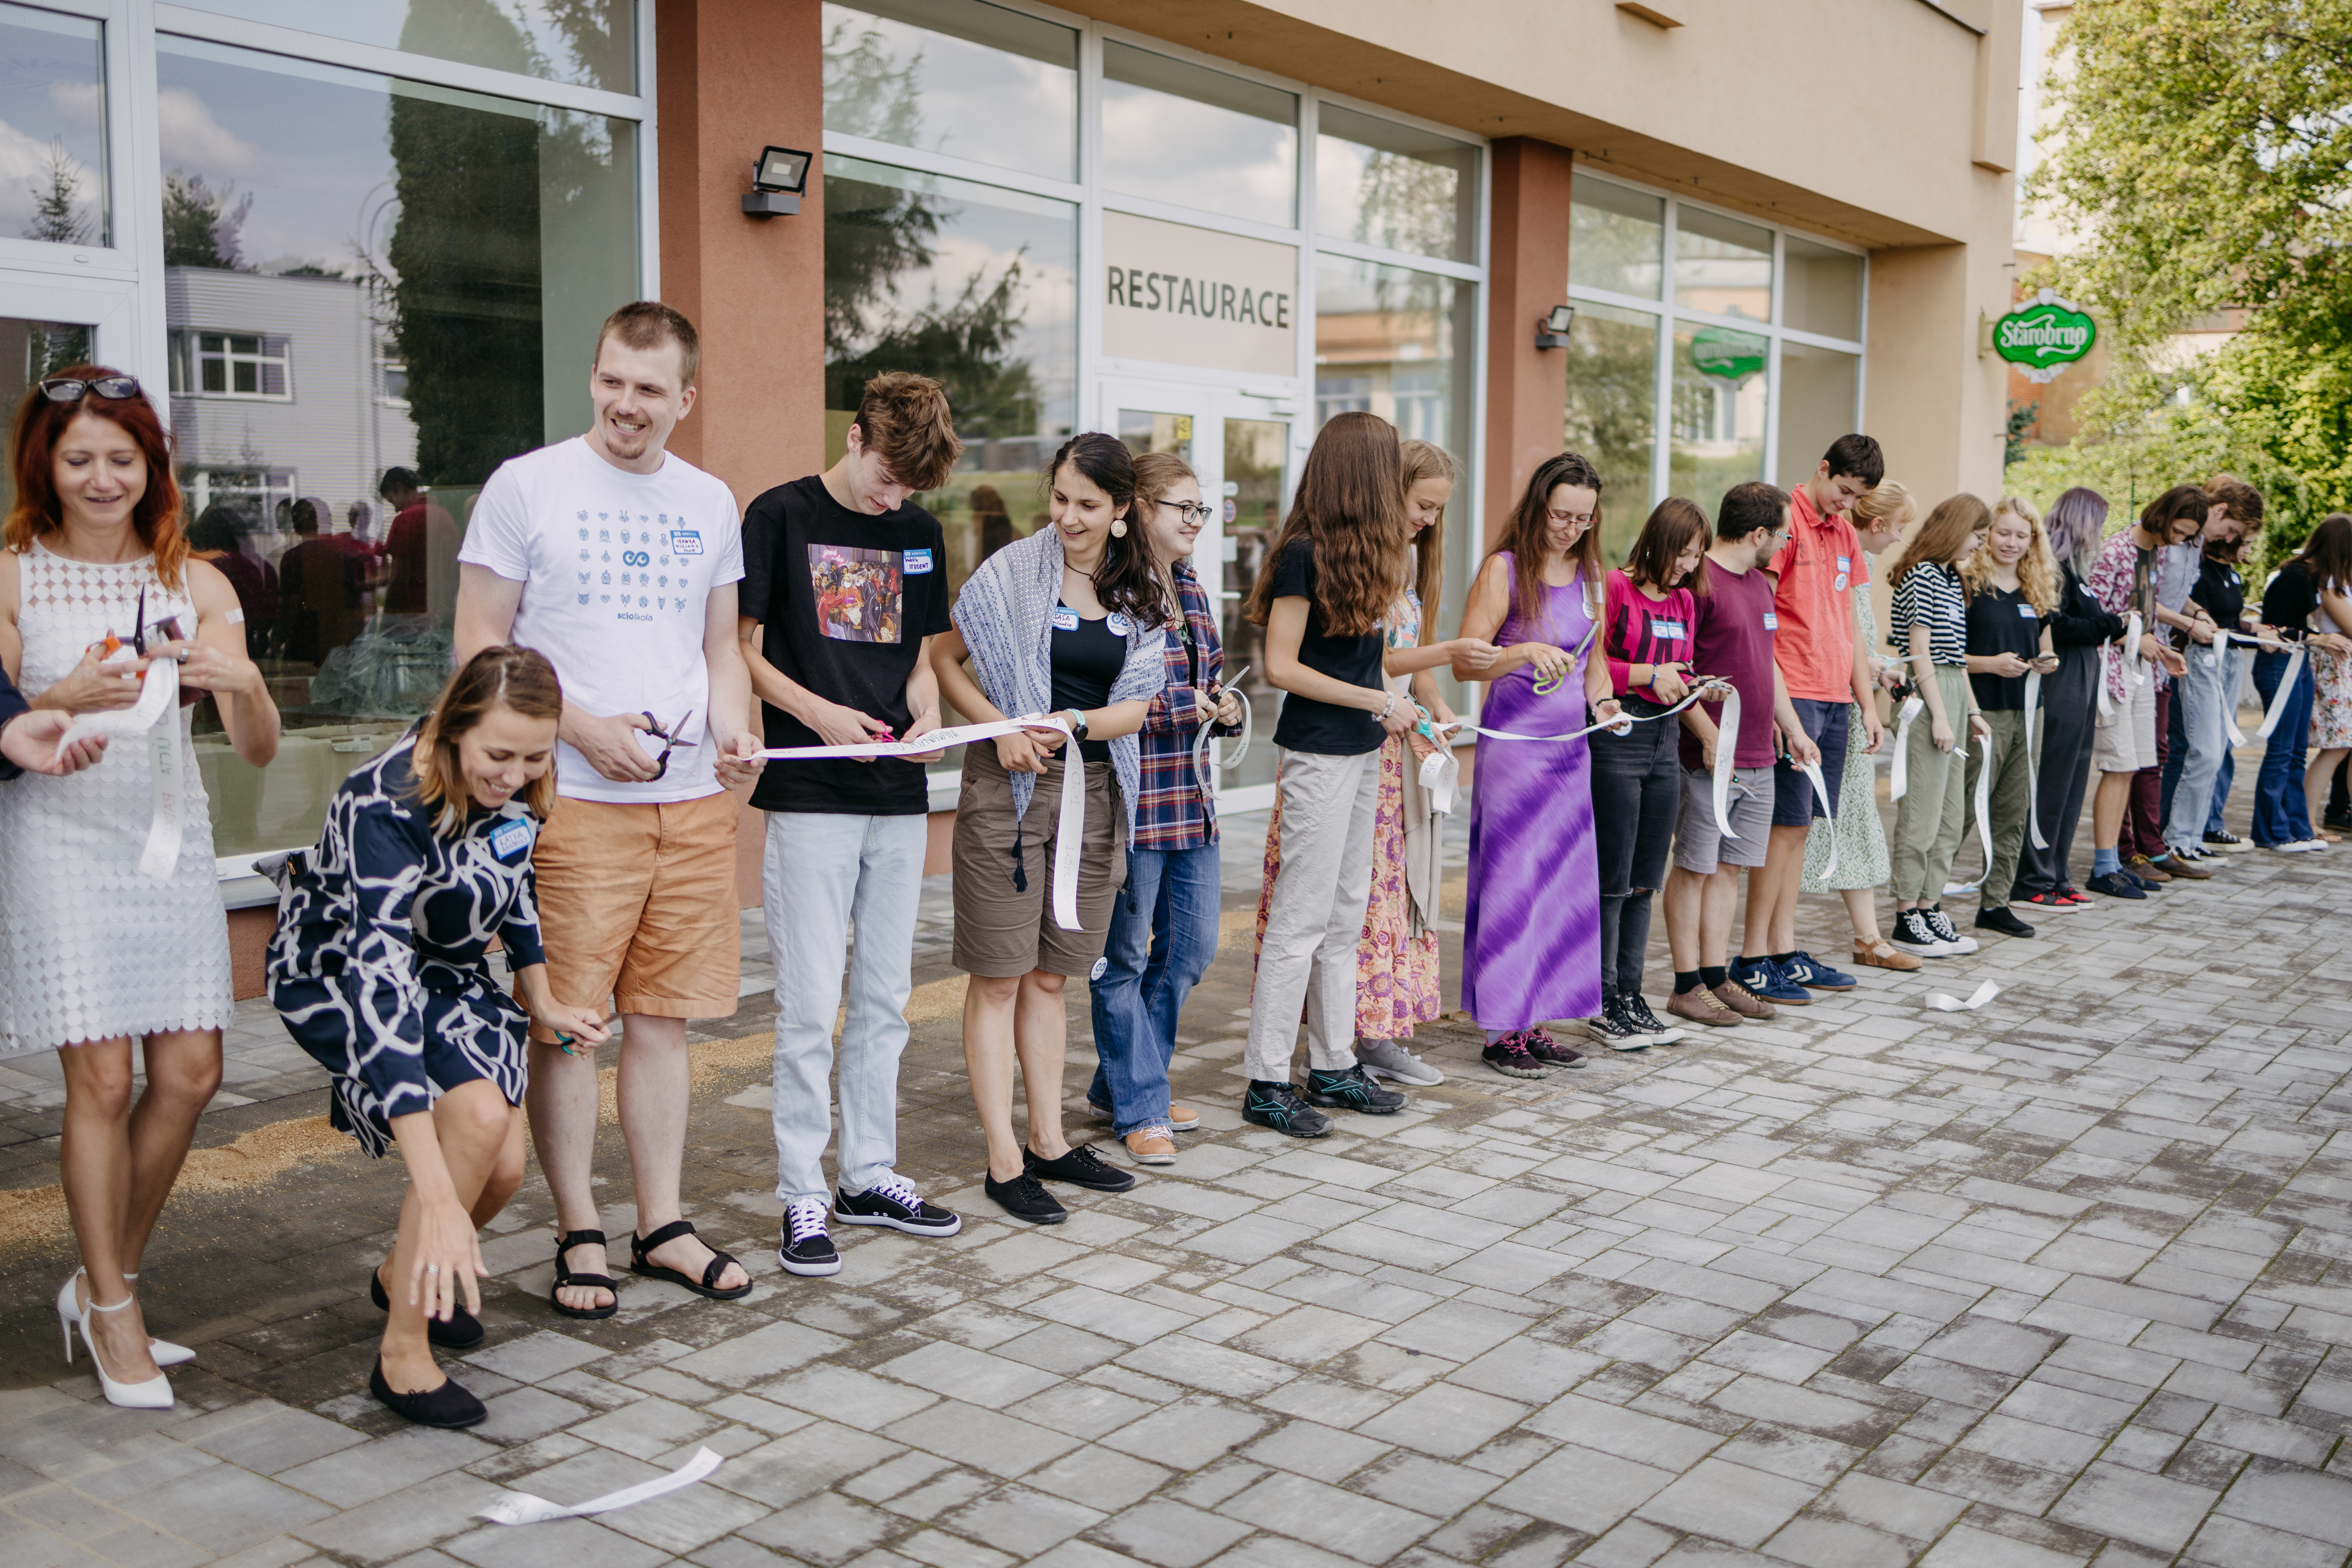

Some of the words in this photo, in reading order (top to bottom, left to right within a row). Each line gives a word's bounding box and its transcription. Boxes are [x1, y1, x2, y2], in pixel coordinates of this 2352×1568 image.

[1108, 266, 1289, 329] RESTAURACE
[2000, 314, 2087, 356] Starobrno
[617, 612, 653, 621] scioškola
[1053, 613, 1070, 621] SAŠA
[1425, 754, 1442, 773] SCIO
